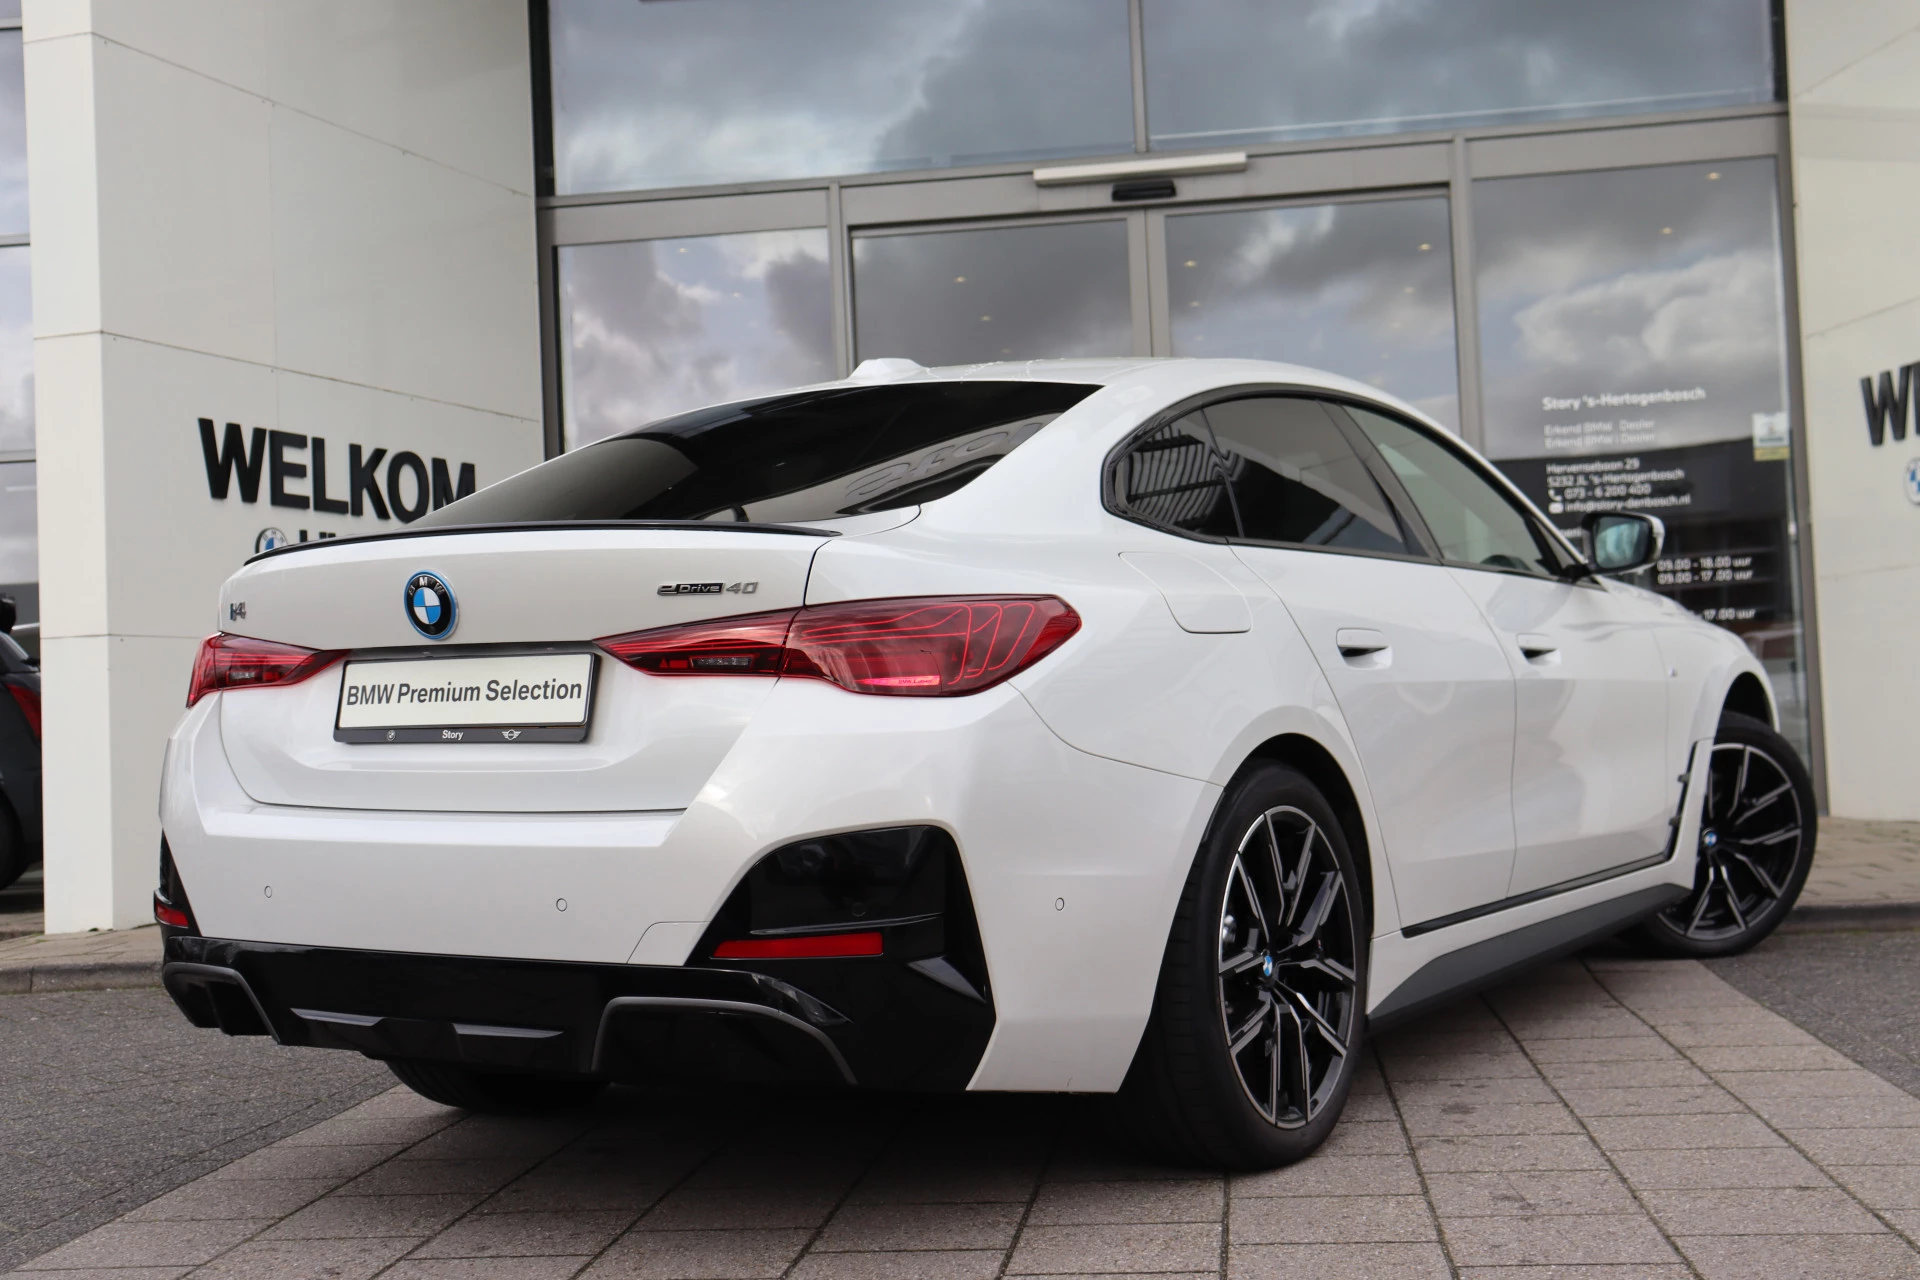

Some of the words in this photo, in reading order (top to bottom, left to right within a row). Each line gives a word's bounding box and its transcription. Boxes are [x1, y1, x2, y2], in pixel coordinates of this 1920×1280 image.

[1542, 396, 1581, 411] Story
[1582, 387, 1706, 408] 's-Hertogenbosch
[1860, 361, 1920, 447] W
[197, 417, 476, 524] WELKOM
[1624, 457, 1640, 470] 29
[1547, 475, 1574, 487] 5232
[1564, 487, 1585, 499] 073
[1604, 484, 1627, 497] 200
[1628, 483, 1651, 495] 400
[408, 576, 446, 597] BMW
[726, 582, 758, 594] 40
[346, 683, 395, 706] BMW
[397, 681, 481, 704] Premium
[485, 678, 582, 702] Selection
[442, 729, 463, 740] Story
